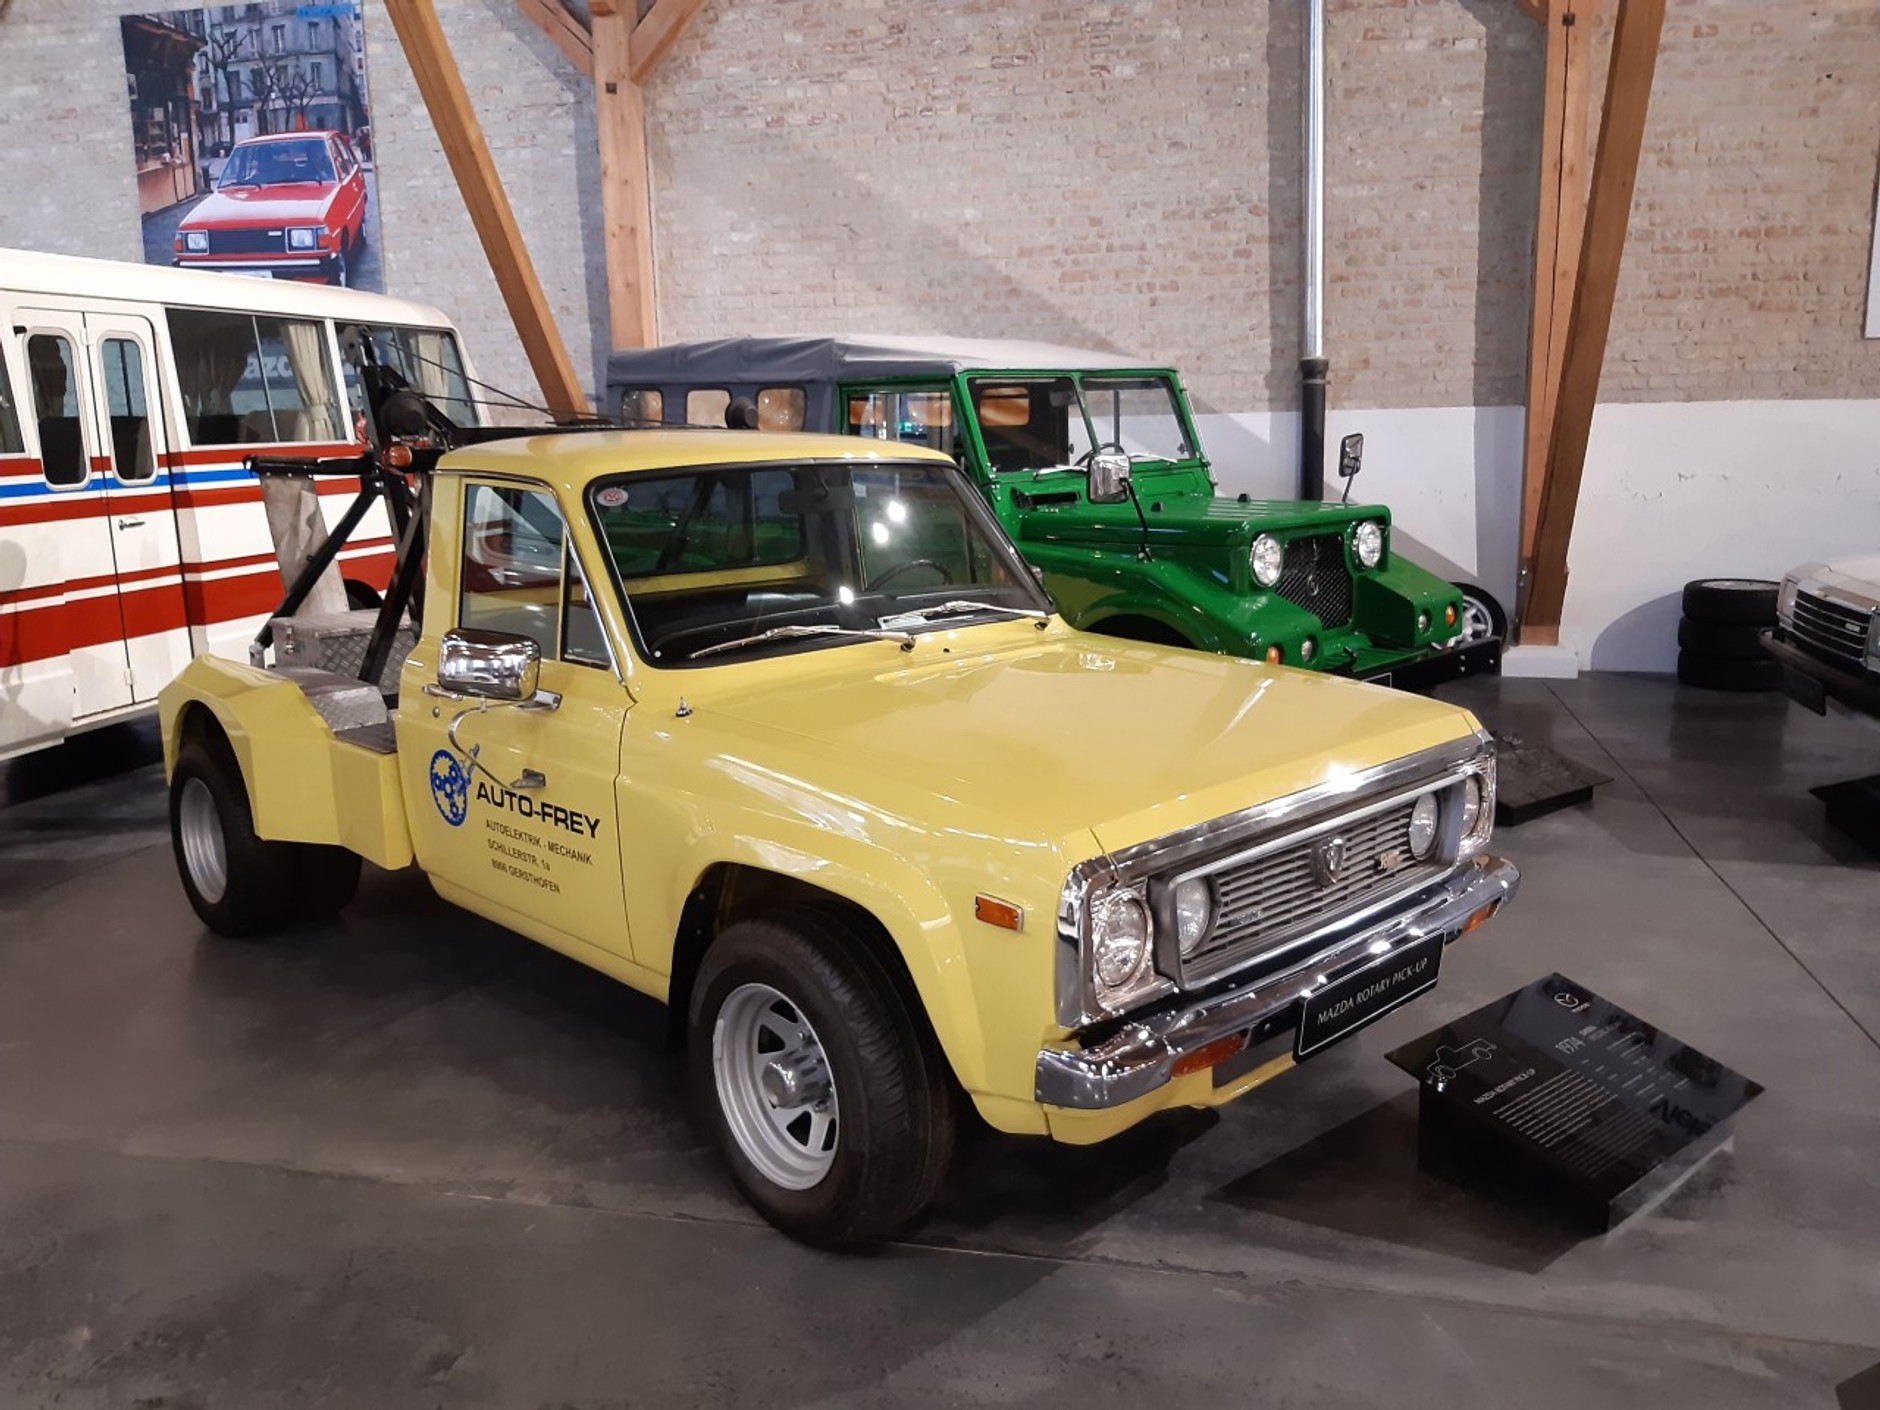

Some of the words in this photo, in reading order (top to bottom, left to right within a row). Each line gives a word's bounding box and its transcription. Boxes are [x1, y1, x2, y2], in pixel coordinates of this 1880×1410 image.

[477, 782, 600, 839] AUTO-FREY
[486, 819, 542, 848] AUTOELEKTRIK
[547, 840, 592, 865] MECHANIK
[1317, 1000, 1354, 1025] MAZDA
[1356, 979, 1390, 1007] ROTARY
[1392, 957, 1428, 984] PICK-UP
